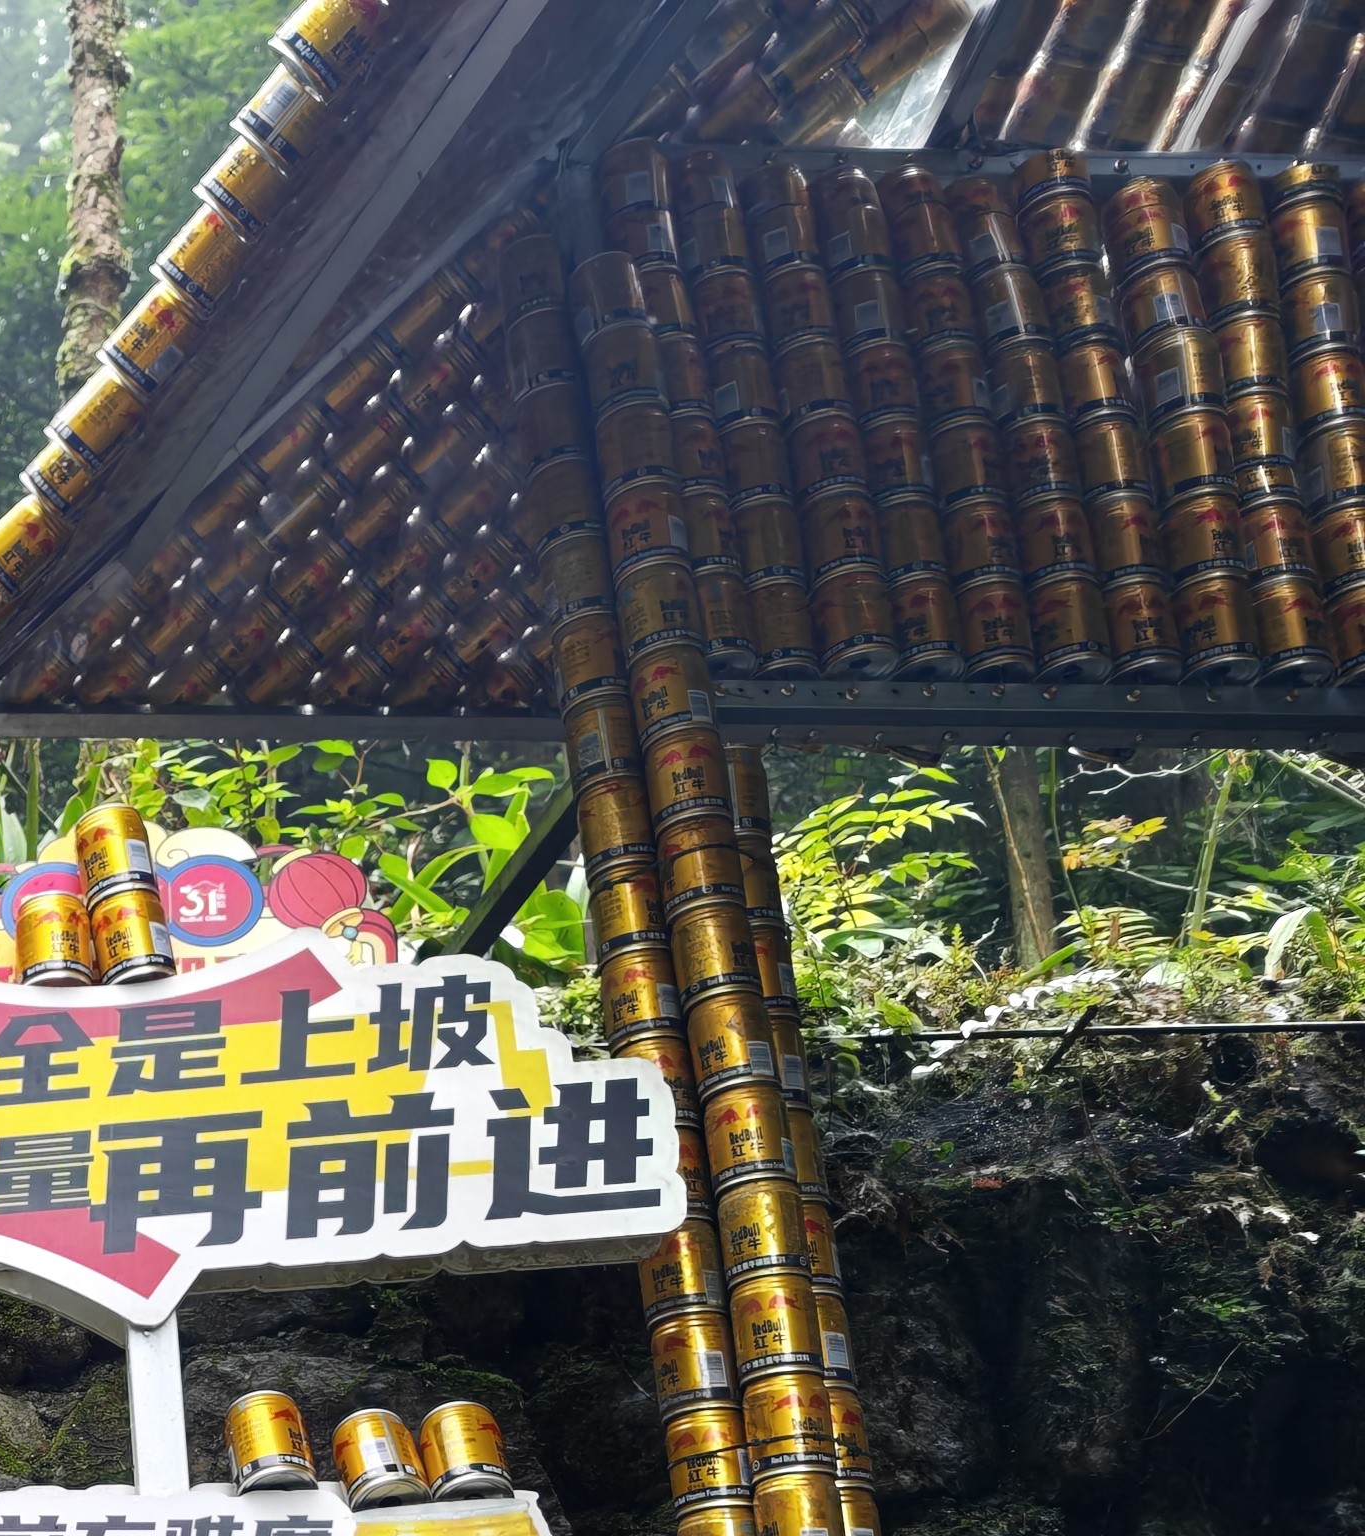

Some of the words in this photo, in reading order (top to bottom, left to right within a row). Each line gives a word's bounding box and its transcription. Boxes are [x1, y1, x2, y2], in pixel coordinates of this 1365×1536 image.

[642, 698, 671, 721] 红牛
[672, 777, 707, 796] 红牛
[86, 862, 109, 880] 红牛
[108, 941, 135, 958] 红牛
[612, 1002, 640, 1021] 红牛
[700, 1050, 728, 1071] 红牛
[728, 1126, 764, 1145] RedBull
[730, 1141, 766, 1158] 红牛
[731, 1236, 762, 1255] 红牛
[751, 1317, 785, 1338] RedBull
[752, 1332, 787, 1351] 红牛
[688, 1466, 720, 1485] 红牛
